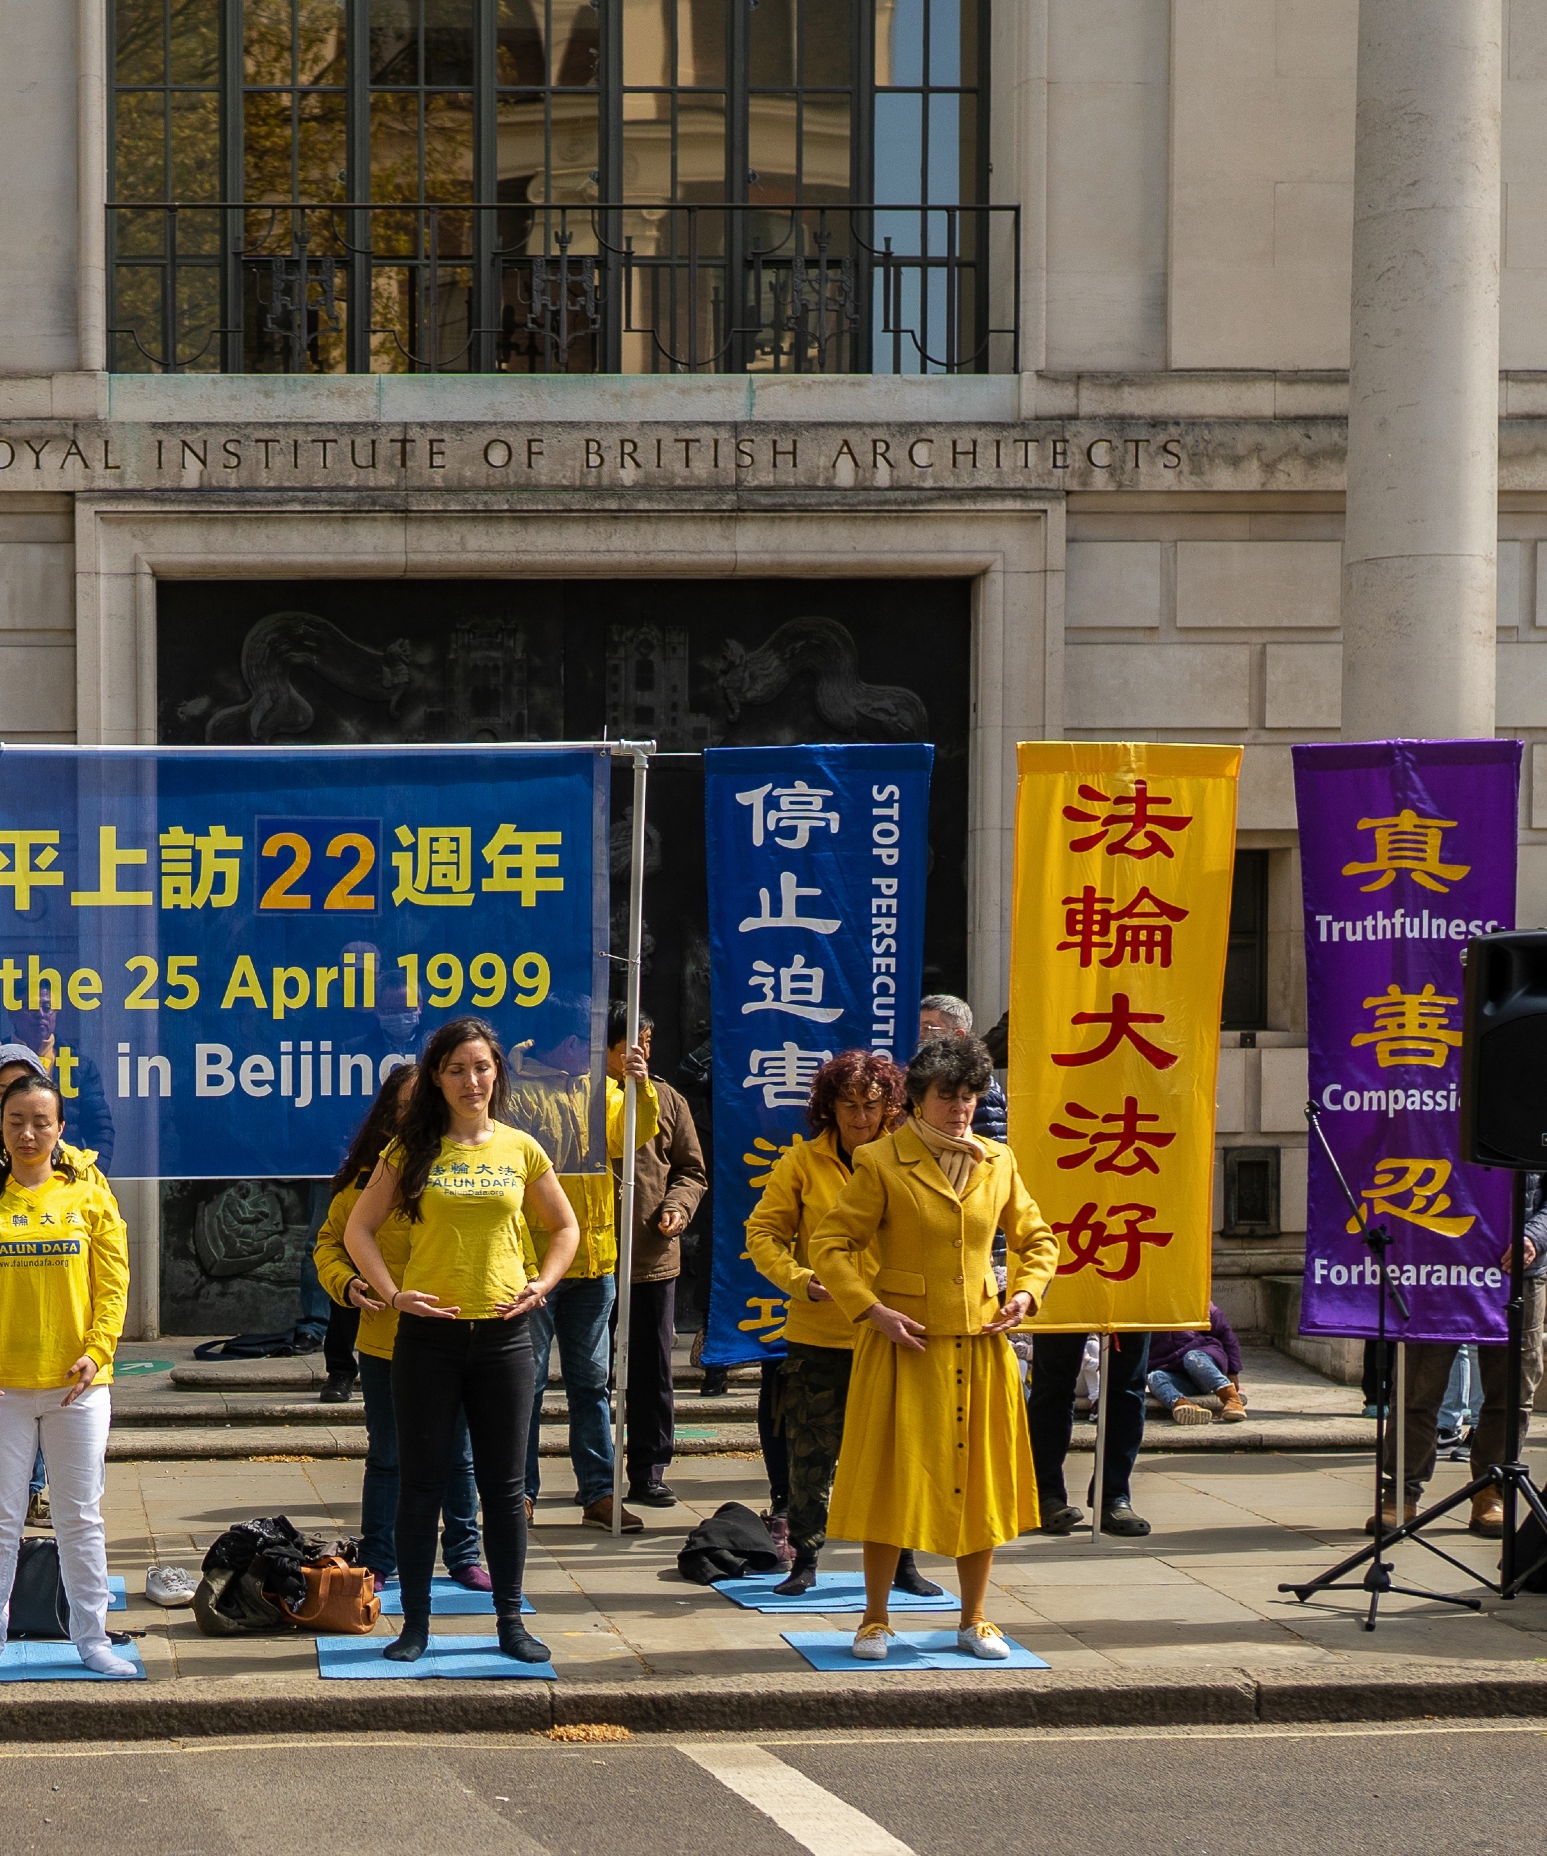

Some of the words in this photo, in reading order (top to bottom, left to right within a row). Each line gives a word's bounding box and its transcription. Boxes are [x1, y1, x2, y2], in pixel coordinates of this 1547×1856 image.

[156, 438, 447, 471] INSTITUTE
[482, 438, 546, 470] OF
[583, 438, 800, 470] BRITISH
[831, 438, 1184, 470] ARCHITECTS
[872, 784, 900, 866] STOP
[1341, 808, 1472, 894] 真
[123, 954, 201, 1010] 25
[220, 952, 376, 1020] April
[397, 951, 552, 1009] 1999
[871, 877, 898, 1064] PERSECUTI
[1048, 779, 1193, 1283] 法輪大法好
[1350, 983, 1463, 1069] 善
[116, 1041, 172, 1098] in
[1321, 1083, 1461, 1119] Compassi
[1345, 1157, 1477, 1238] 忍
[42, 1242, 78, 1254] DAFA
[1313, 1256, 1503, 1289] Forbearance
